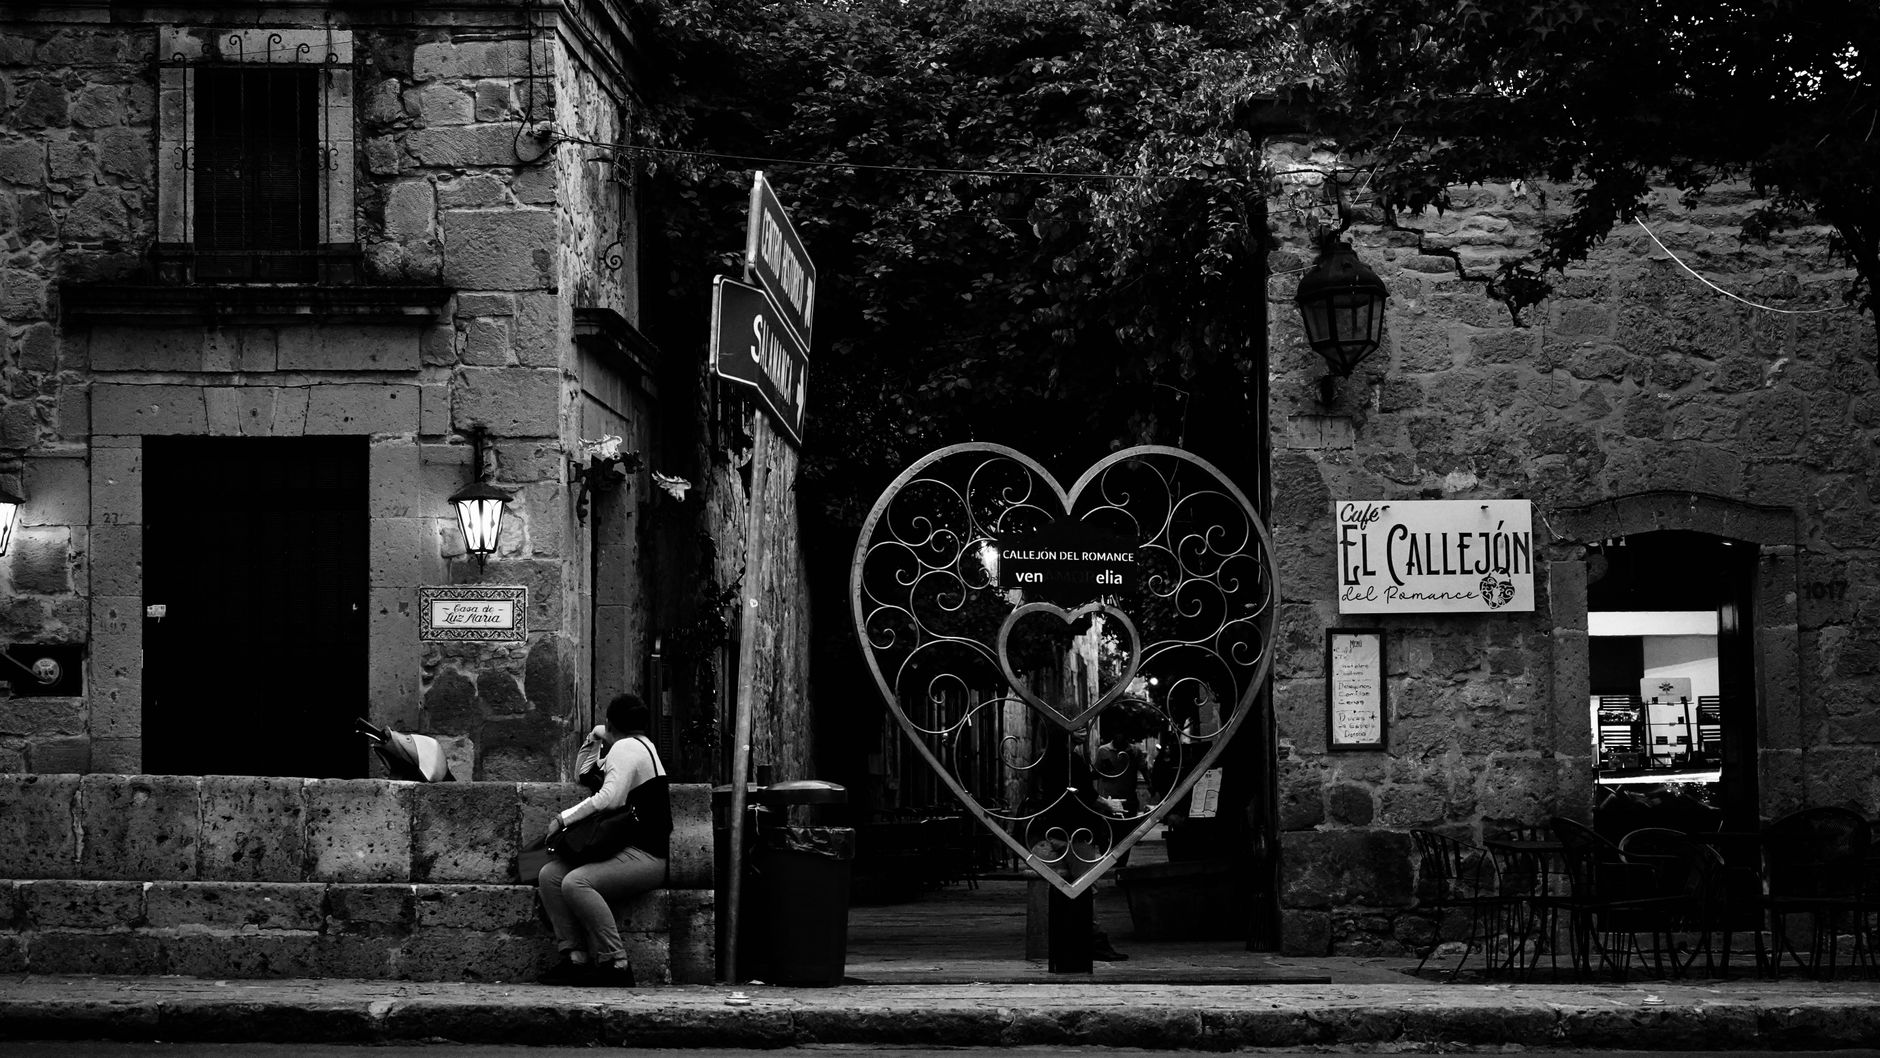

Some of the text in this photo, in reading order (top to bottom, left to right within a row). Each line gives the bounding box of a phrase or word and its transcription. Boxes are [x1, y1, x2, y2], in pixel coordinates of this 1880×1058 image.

[1059, 551, 1080, 561] DEL
[1082, 551, 1135, 563] ROMANCE
[1339, 520, 1532, 586] EL CALLEJÓN
[1015, 571, 1044, 583] ven
[1341, 585, 1479, 604] del Romance
[453, 603, 495, 613] Casa de
[442, 612, 465, 625] Luz
